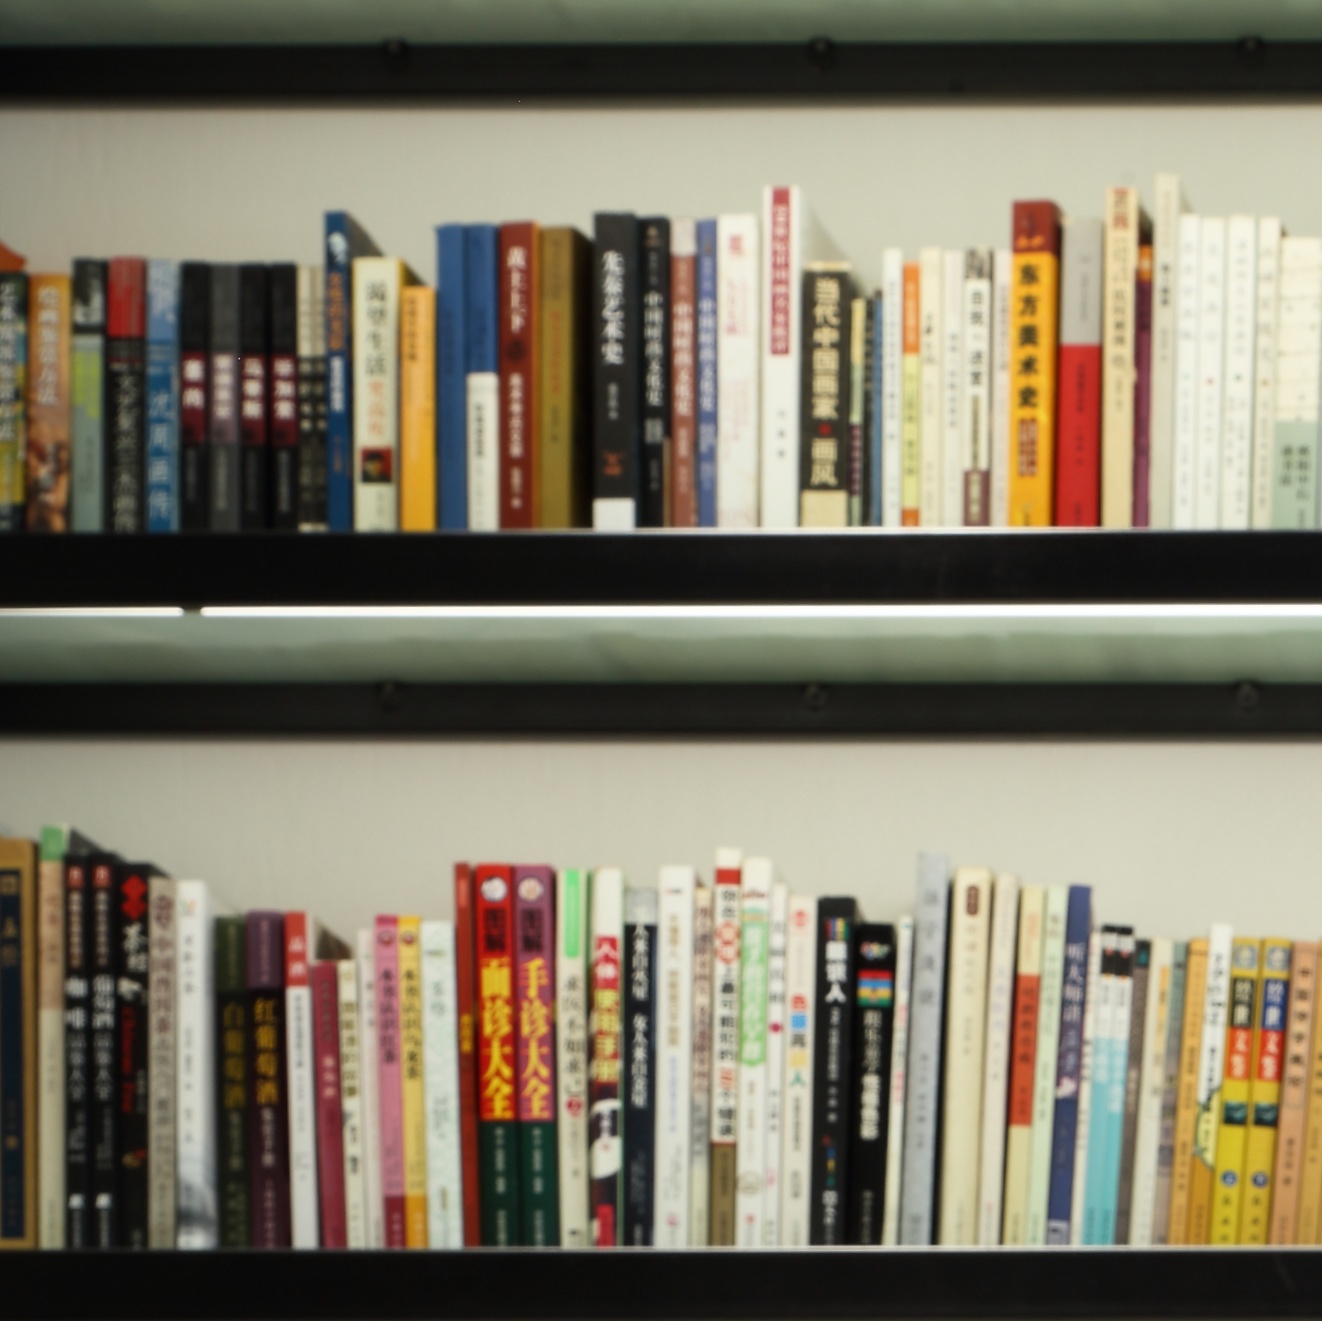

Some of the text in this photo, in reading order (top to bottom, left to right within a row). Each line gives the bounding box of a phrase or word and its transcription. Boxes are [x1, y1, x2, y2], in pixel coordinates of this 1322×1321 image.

[1018, 264, 1040, 408] 东方美术史
[481, 957, 515, 1119] 面诊大全
[520, 957, 550, 1119] 手诊大全
